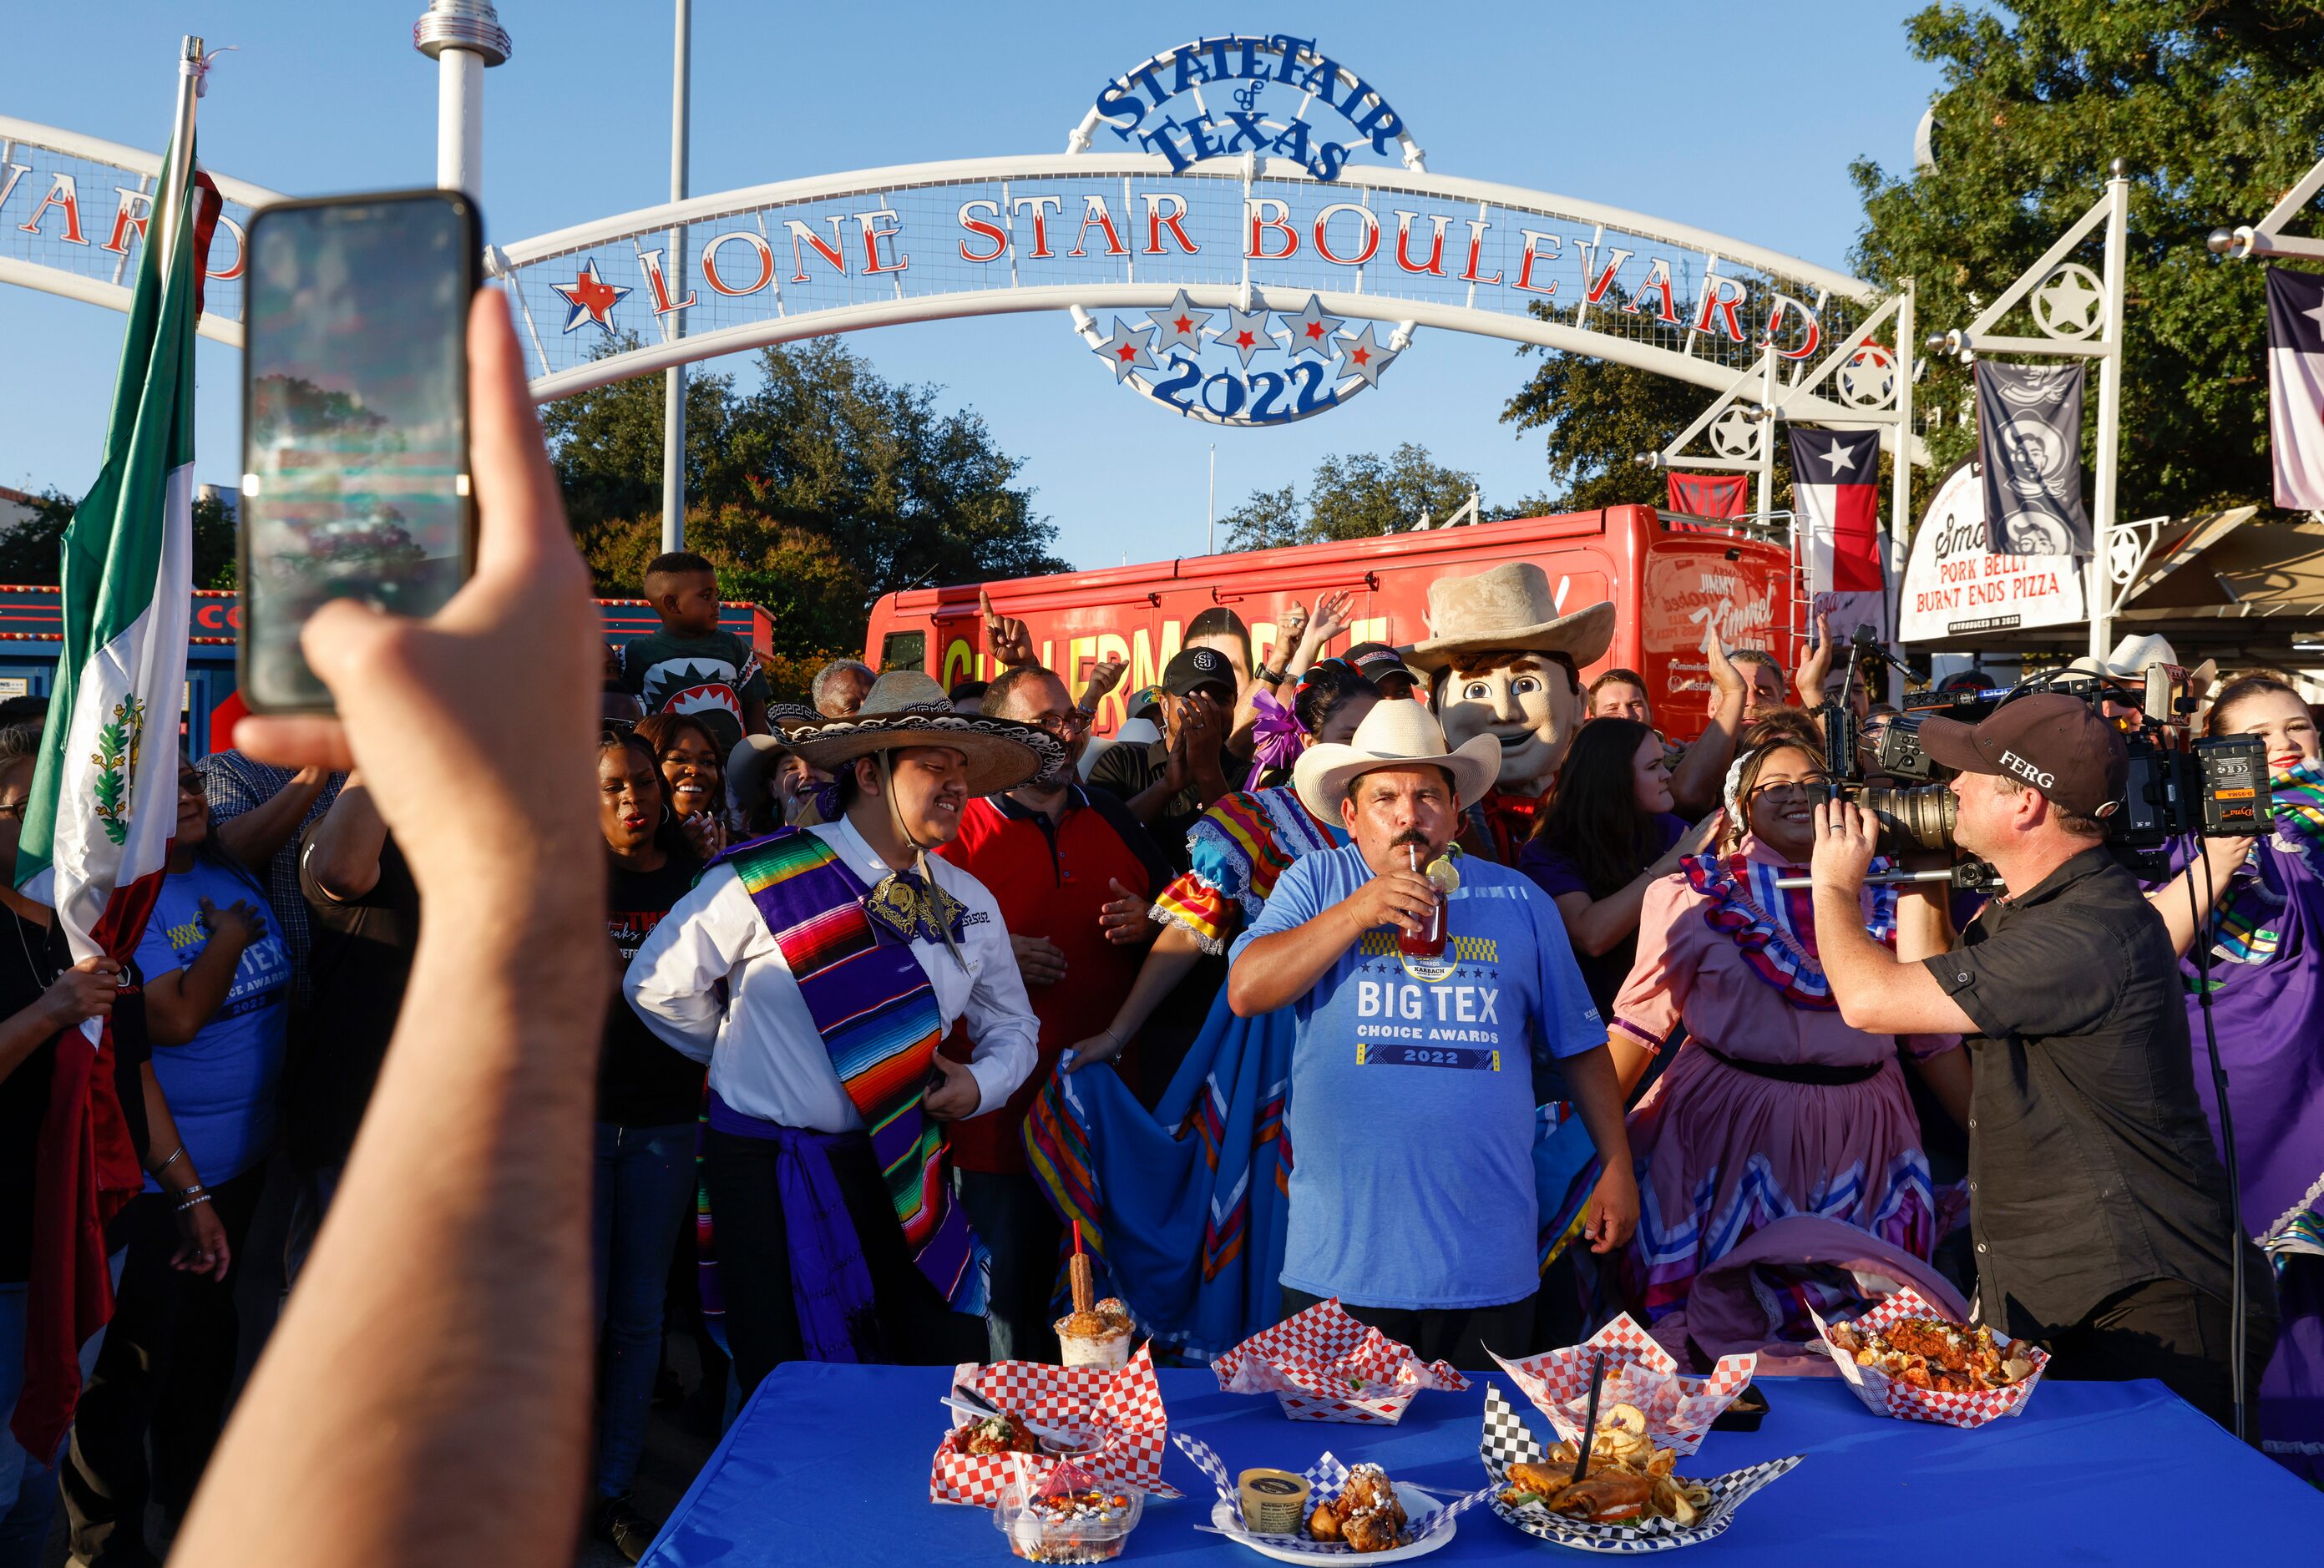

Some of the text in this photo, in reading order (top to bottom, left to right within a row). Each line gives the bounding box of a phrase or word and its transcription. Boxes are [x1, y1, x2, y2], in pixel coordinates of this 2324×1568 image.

[1096, 32, 1404, 157] STATE FAIR
[1233, 79, 1265, 111] of
[1137, 109, 1351, 182] TEXAS
[636, 192, 1821, 361] LONE STAR BOULEVARD
[1152, 352, 1339, 423] 2022
[1699, 574, 1735, 596] JIMMY
[1940, 553, 2028, 584] PORK BELLY
[1916, 572, 2060, 613] BURNT ENDS PIZZA
[1689, 583, 1774, 656] Kimmel
[2002, 615, 2019, 625] 2022
[1998, 749, 2055, 789] FERG
[241, 938, 285, 976] TEX
[1414, 966, 1446, 974] KARBACH
[246, 969, 289, 994] AWARDS
[232, 995, 267, 1015] 2022
[1357, 981, 1500, 1025] BIG TEX
[1357, 1024, 1500, 1044] CHOICE AWARDS
[1404, 1049, 1459, 1065] 2022
